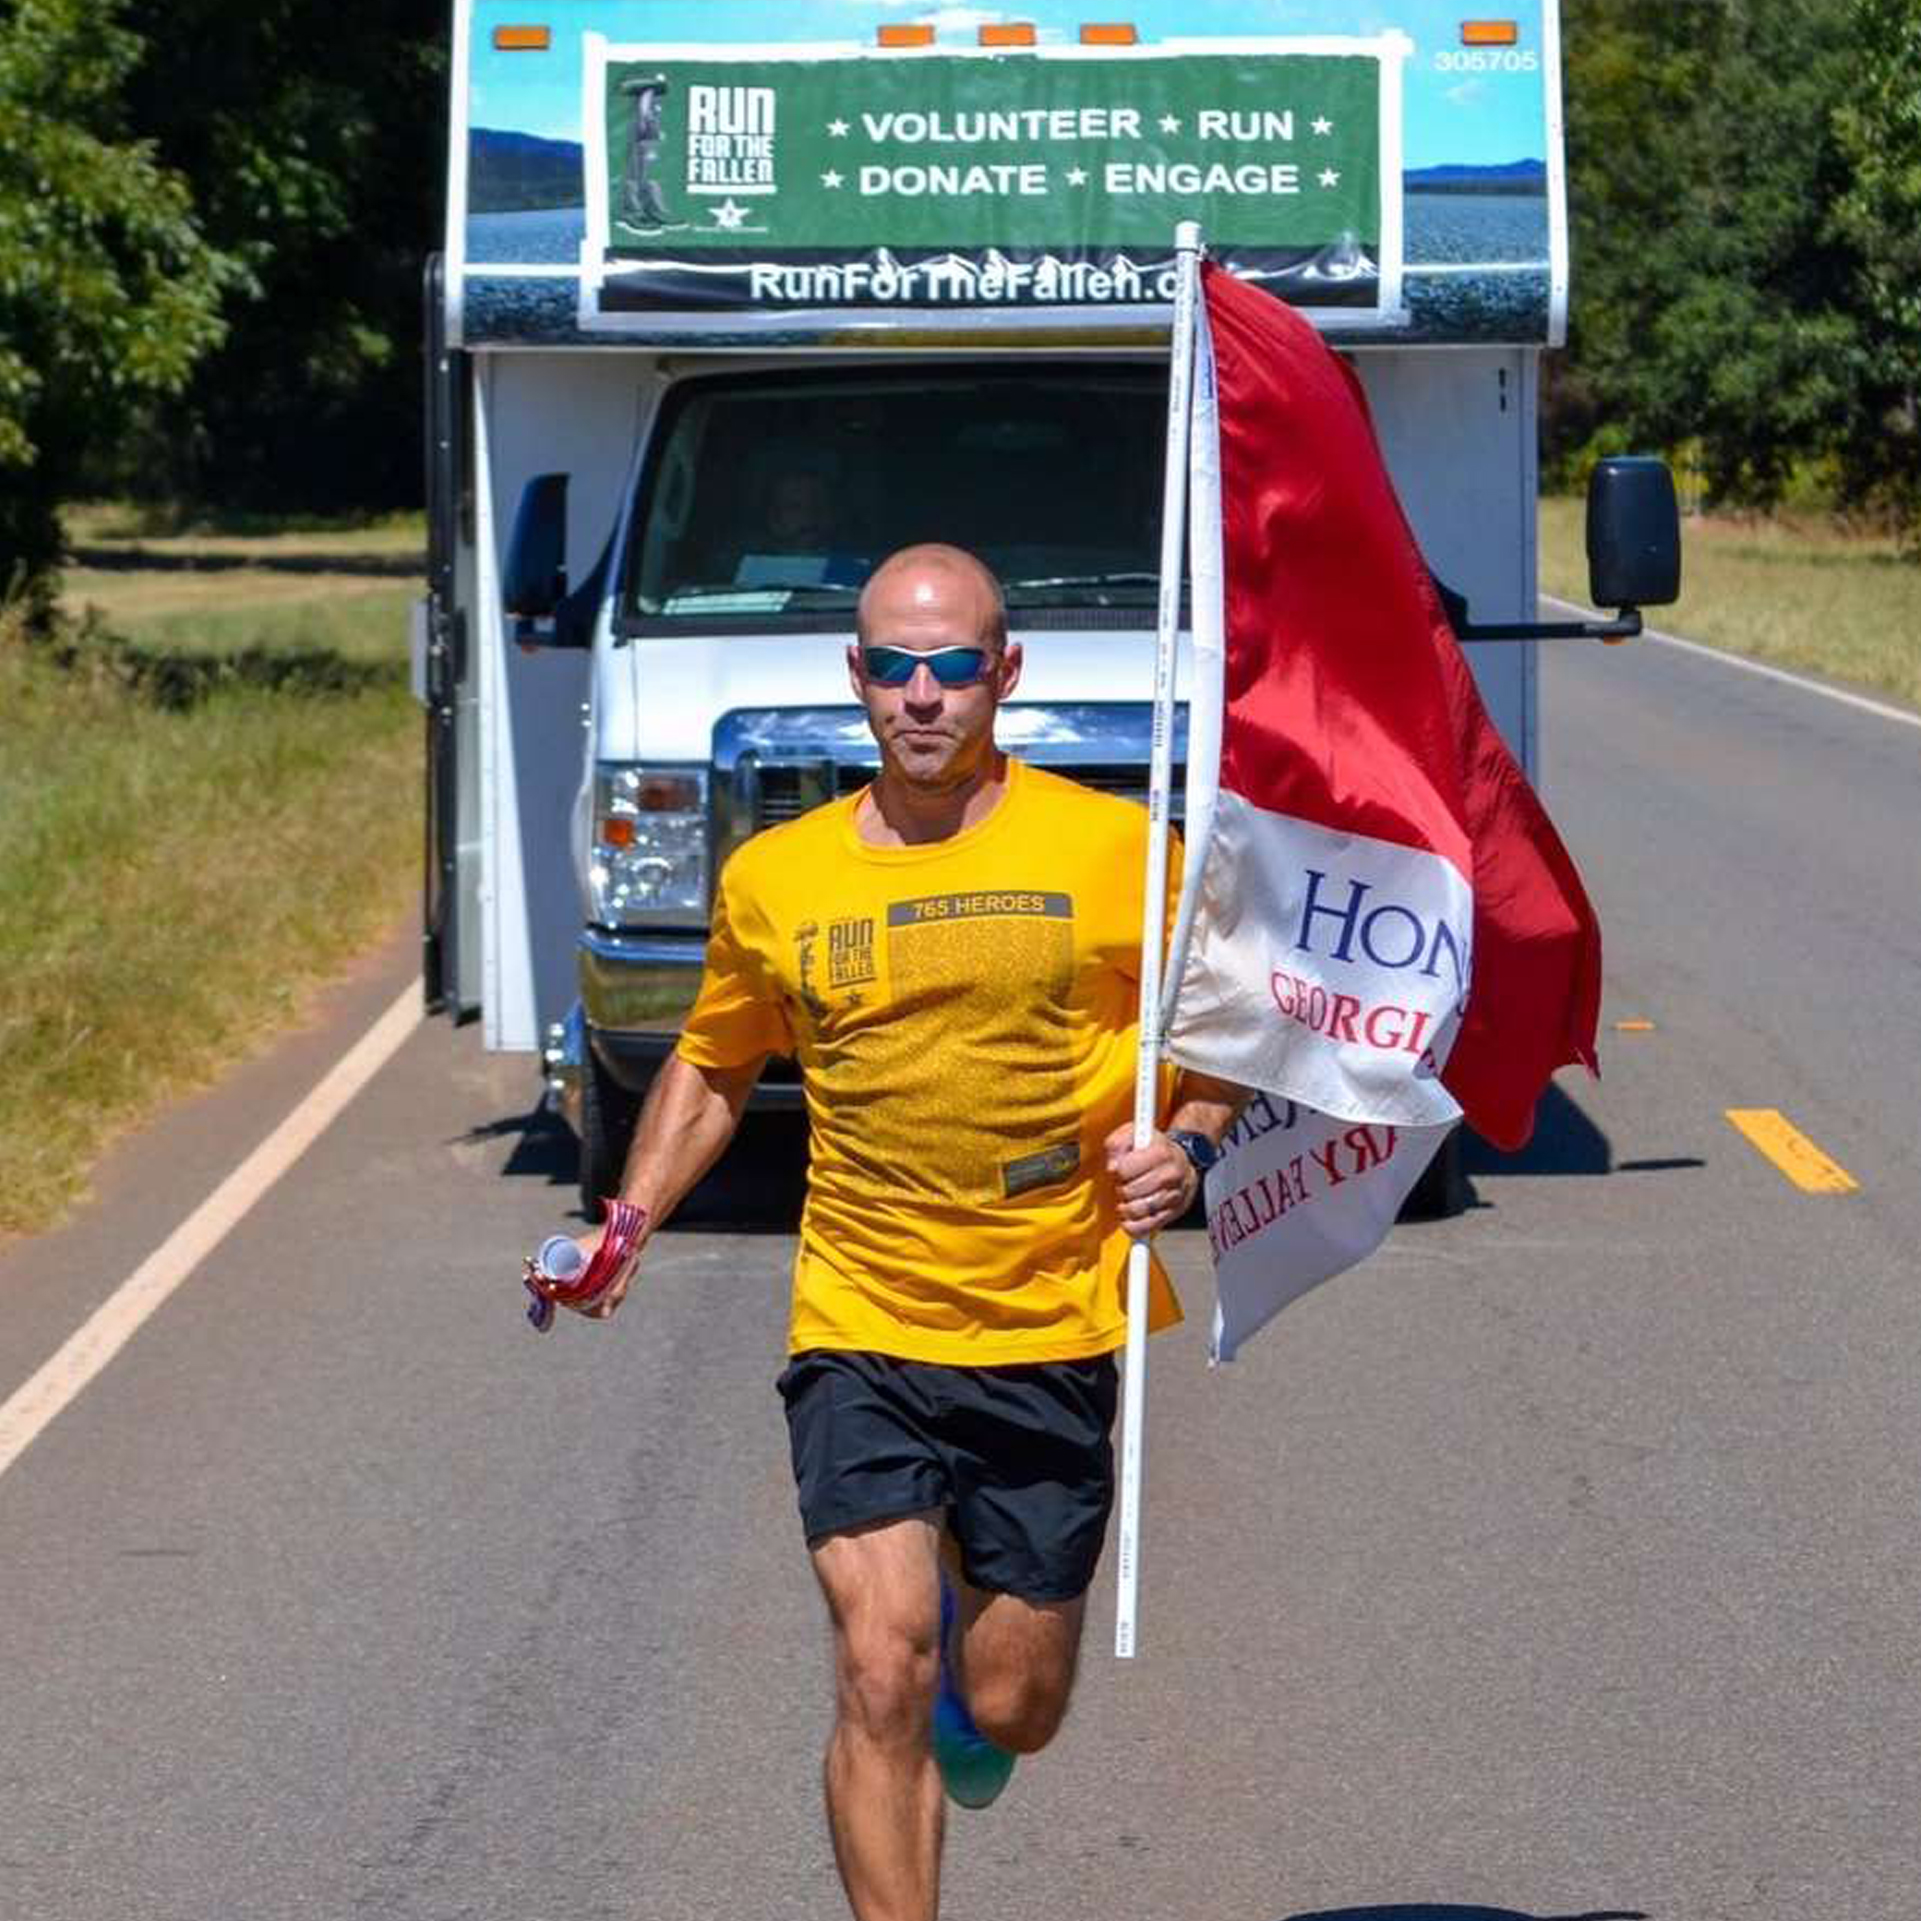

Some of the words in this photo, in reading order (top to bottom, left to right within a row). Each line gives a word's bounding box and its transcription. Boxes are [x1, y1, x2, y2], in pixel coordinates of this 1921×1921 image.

[1434, 50, 1538, 71] 305705
[689, 85, 776, 134] RUN
[861, 110, 1141, 142] VOLUNTEER
[1198, 111, 1294, 141] RUN
[689, 134, 732, 159] FOR
[733, 134, 774, 158] THE
[688, 158, 774, 183] FALLEN
[859, 164, 1048, 195] DONATE
[1104, 164, 1299, 194] ENGAGE
[914, 898, 949, 918] 765
[955, 894, 1046, 914] HEROES
[829, 918, 873, 951] RUN
[1296, 869, 1471, 1000] HON
